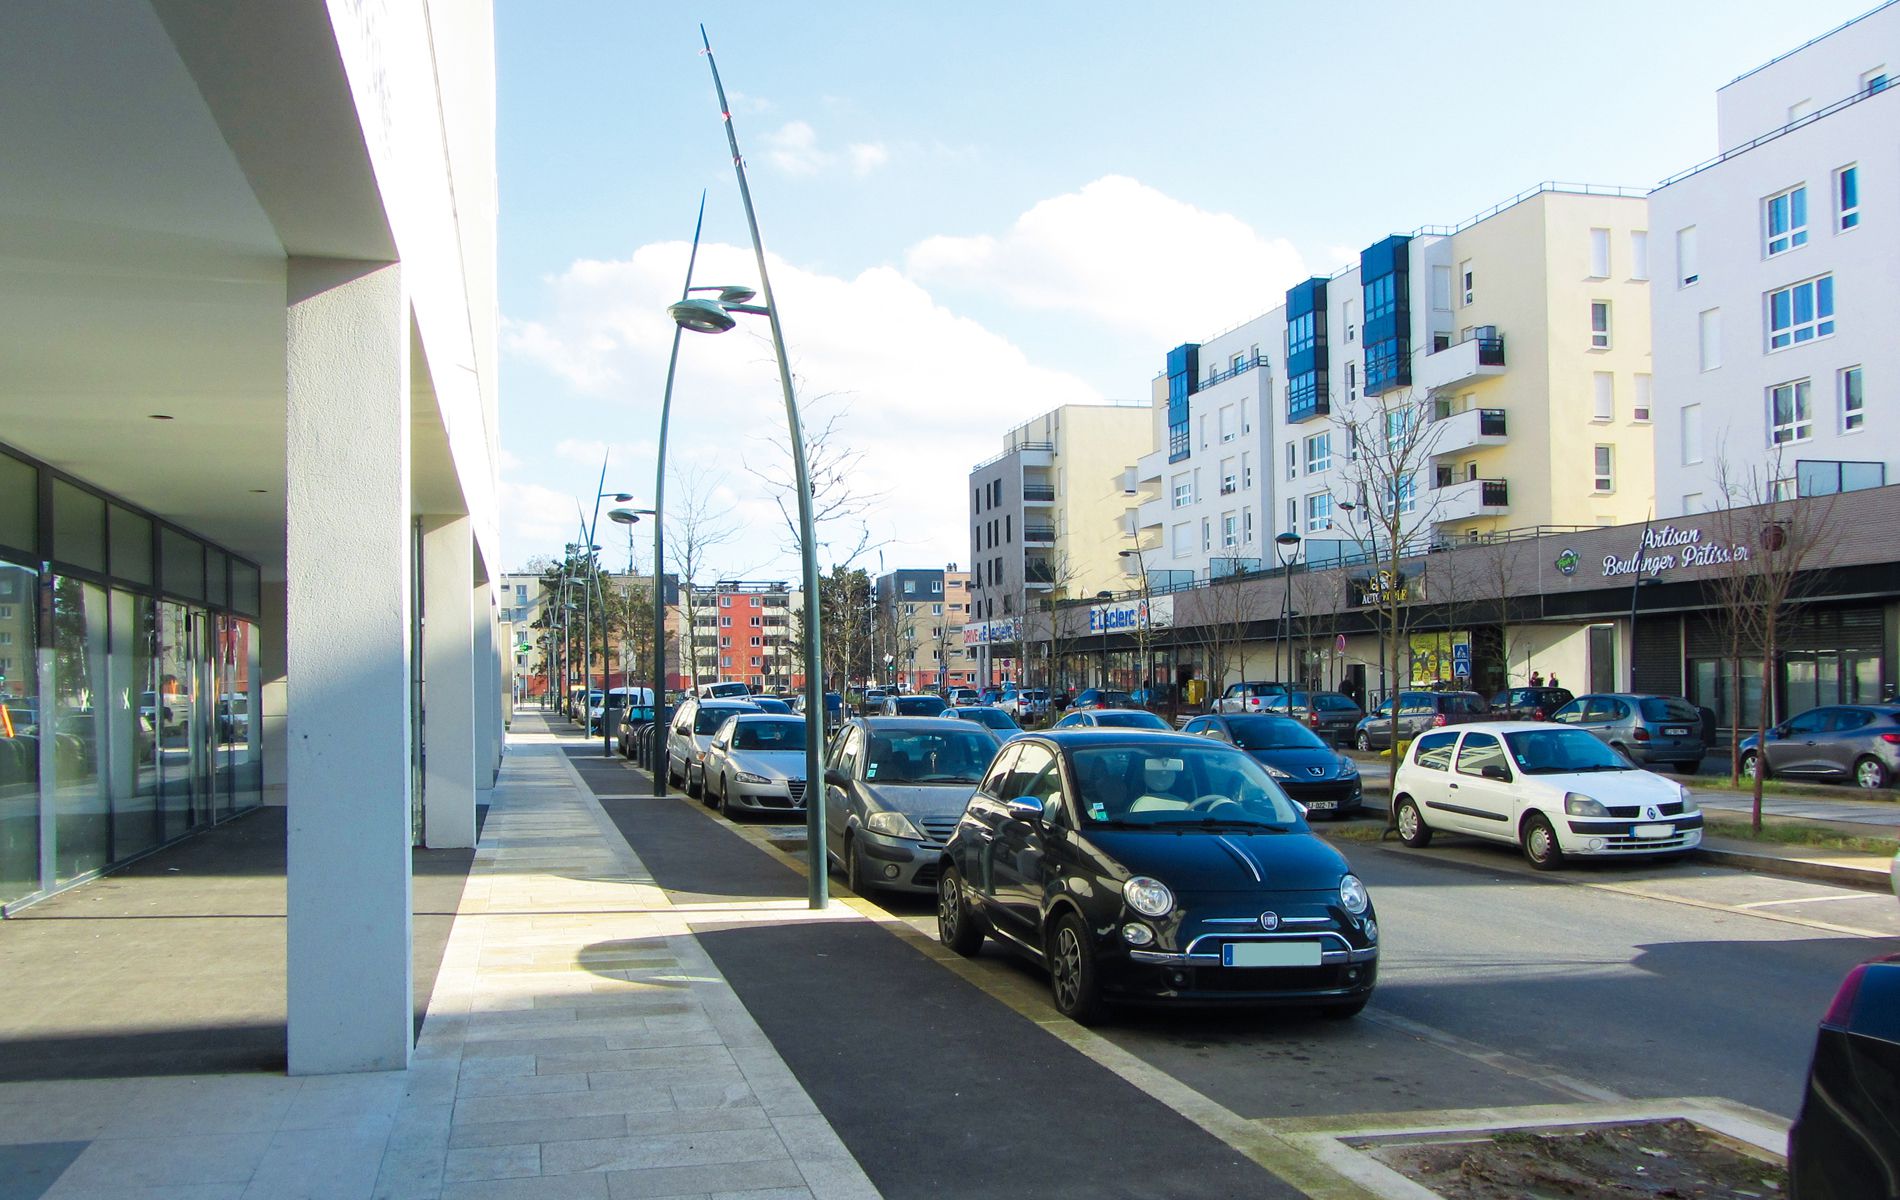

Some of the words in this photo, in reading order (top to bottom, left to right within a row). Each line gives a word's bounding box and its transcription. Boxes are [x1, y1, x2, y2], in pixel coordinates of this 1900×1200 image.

[1640, 525, 1700, 549] Artisan
[1602, 551, 1676, 577] Boulanger
[1681, 542, 1748, 568] Pâtisser
[1089, 607, 1136, 631] E.Leclerc
